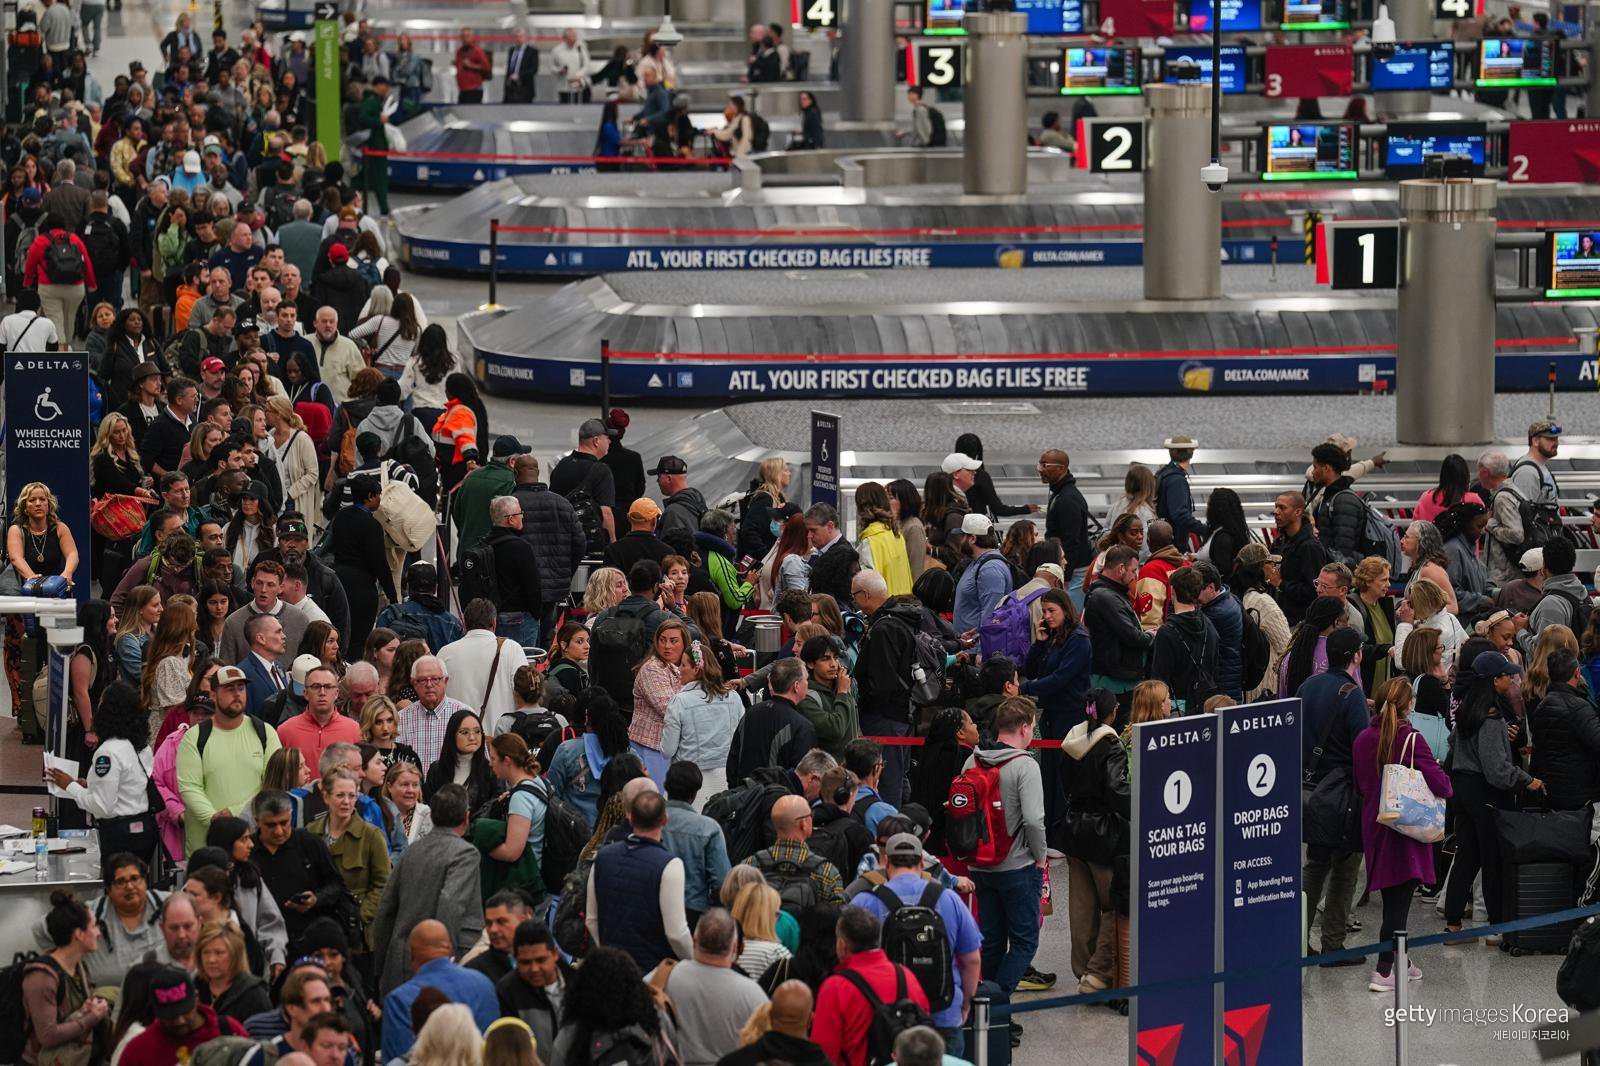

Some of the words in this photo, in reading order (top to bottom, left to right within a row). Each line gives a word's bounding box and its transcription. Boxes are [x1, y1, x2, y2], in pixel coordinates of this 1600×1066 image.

[806, 0, 834, 25] 4
[1101, 17, 1115, 36] 4
[927, 48, 954, 85] 3
[1267, 73, 1282, 96] 3
[1101, 127, 1132, 169] 2
[1512, 155, 1529, 180] 2
[627, 250, 658, 270] ATL,
[661, 250, 703, 268] YOUR
[706, 250, 748, 268] FIRST
[749, 249, 817, 267] CHECKED
[820, 249, 852, 267] BAG
[853, 248, 892, 266] FLIES
[1358, 233, 1374, 284] 1
[28, 361, 70, 370] DELTA
[1224, 368, 1310, 382] DELTA.COM/AMEX
[728, 370, 766, 392] ATL,
[768, 370, 818, 390] YOUR
[822, 370, 869, 388] FIRST
[872, 368, 954, 388] CHECKED
[956, 368, 992, 388] BAG
[996, 368, 1042, 388] FLIES
[15, 429, 82, 438] WHEELCHAIR
[17, 440, 80, 448] ASSISTANCE
[1244, 714, 1282, 731] DELTA
[1160, 731, 1199, 748] DELTA
[1256, 762, 1268, 788] 2
[1174, 780, 1181, 804] 1
[1234, 810, 1262, 825] DROP
[1263, 805, 1289, 820] BAGS
[1148, 826, 1174, 844] SCAN
[1176, 826, 1184, 838] &
[1185, 822, 1206, 836] TAG
[1242, 823, 1268, 840] WITH
[1270, 822, 1281, 836] ID
[1149, 842, 1177, 858] YOUR
[1179, 838, 1205, 854] BAGS
[1234, 860, 1246, 870] FOR
[1247, 856, 1272, 868] ACCESS:
[1148, 880, 1160, 888] Scan
[1160, 878, 1172, 887] your
[1182, 872, 1204, 882] boarding
[1248, 881, 1258, 890] App
[1258, 877, 1280, 887] Boarding
[1148, 890, 1160, 898] pass
[1166, 886, 1180, 894] kiosk
[1186, 883, 1198, 893] print
[1248, 893, 1280, 904] Identification
[1280, 890, 1296, 898] Ready
[1148, 900, 1158, 908] bag
